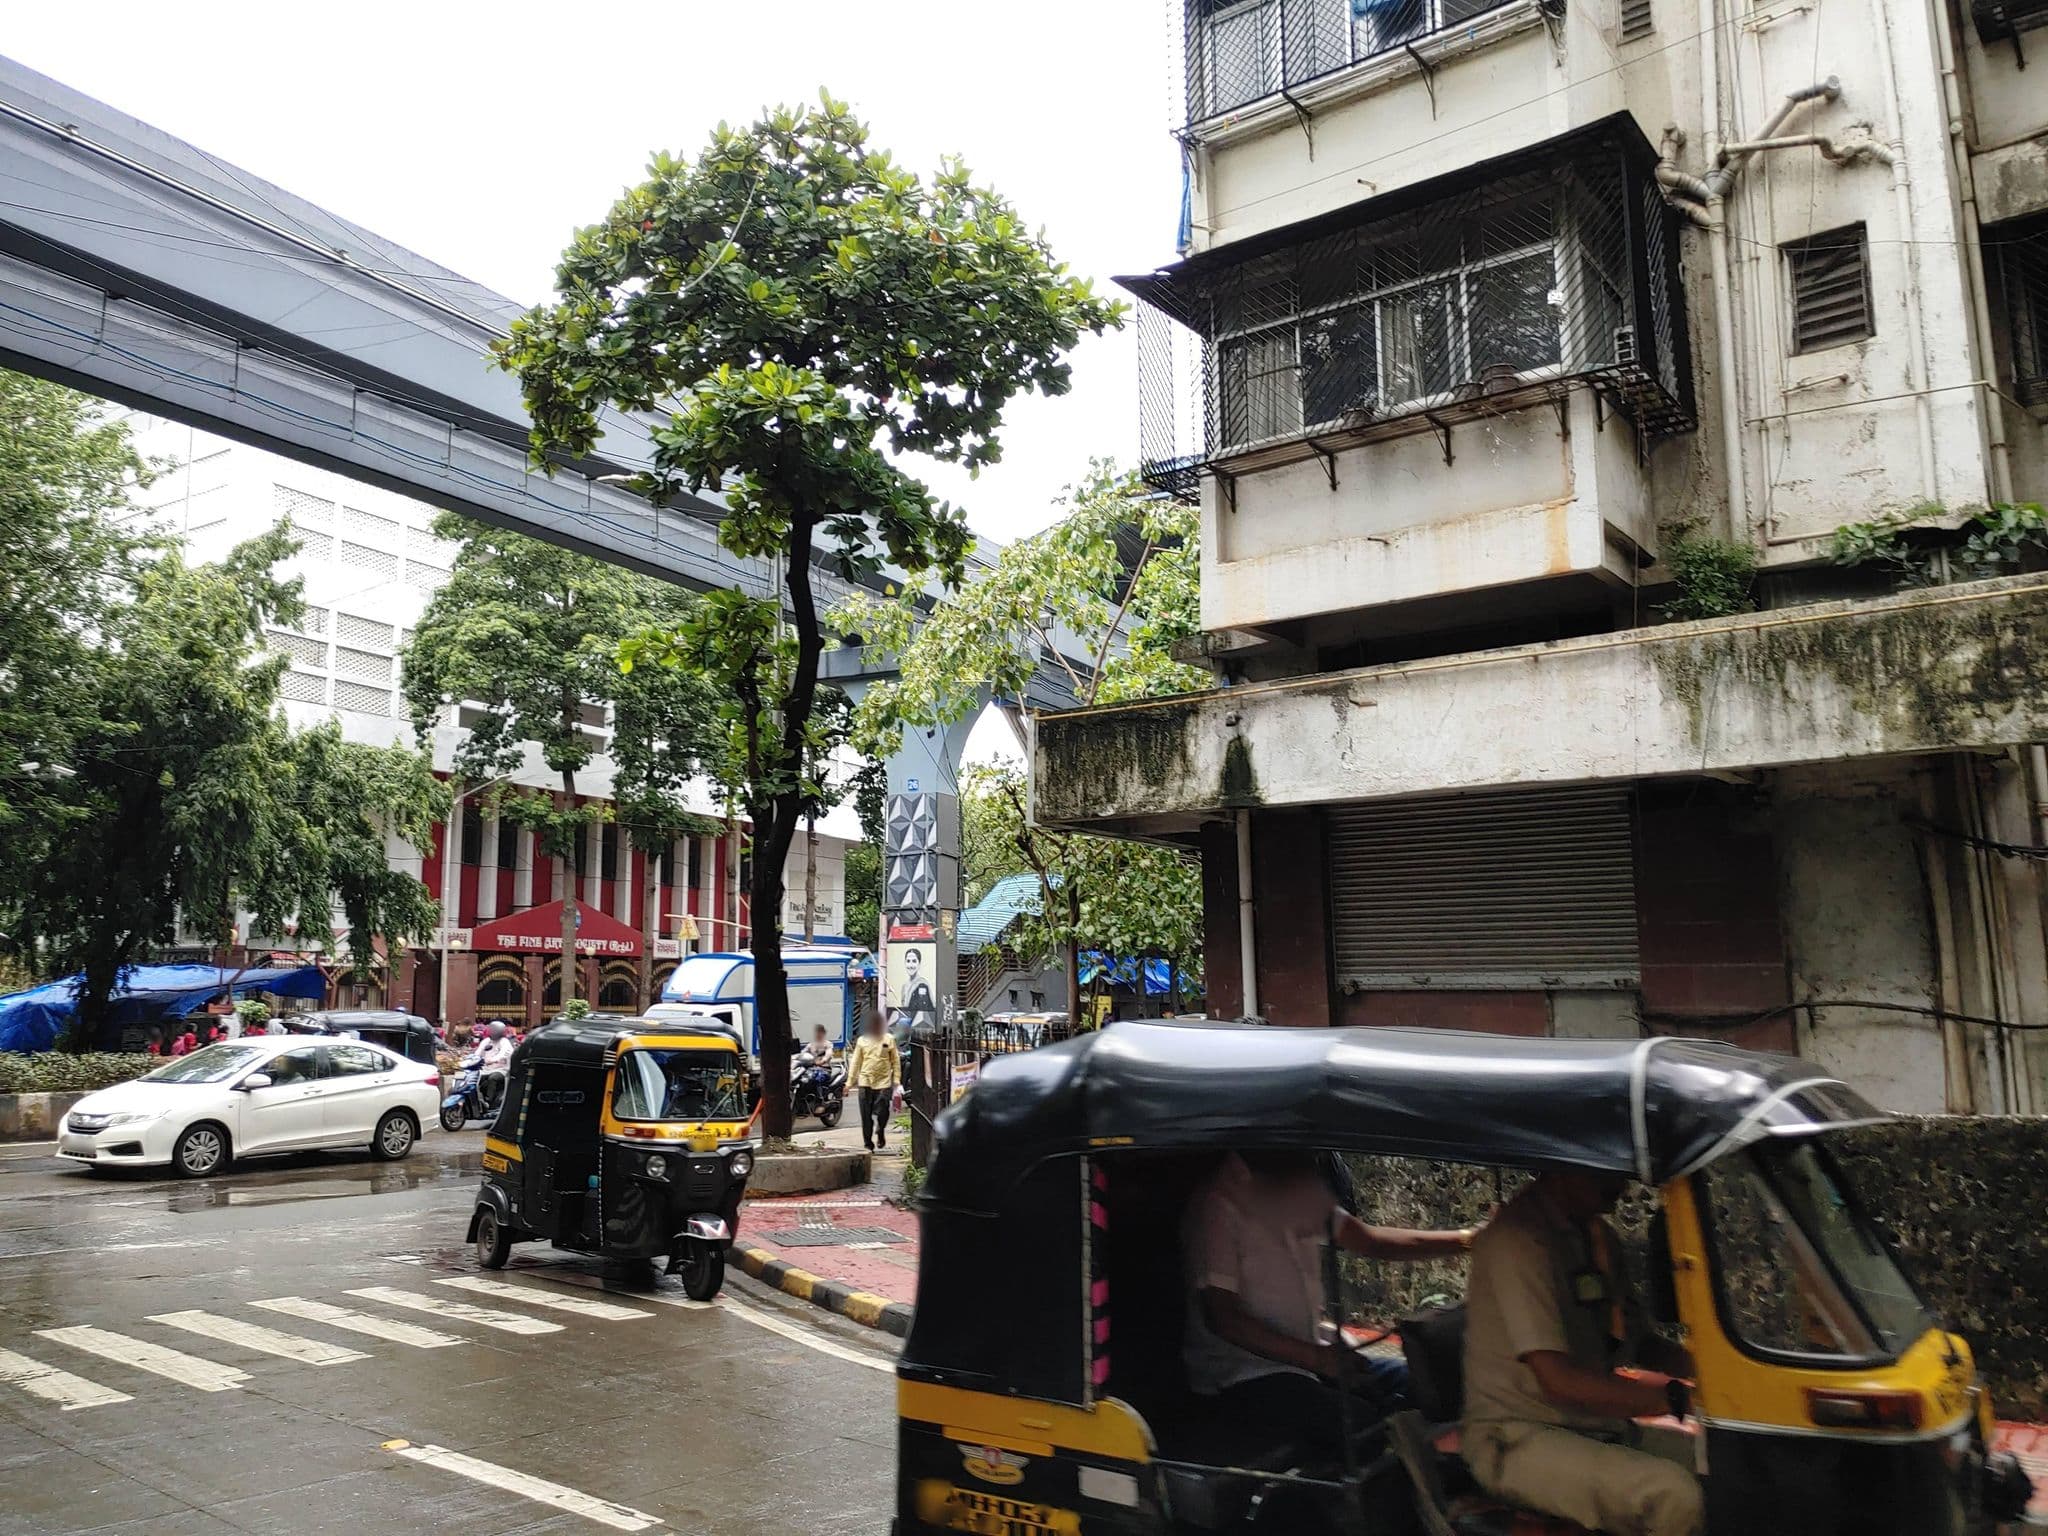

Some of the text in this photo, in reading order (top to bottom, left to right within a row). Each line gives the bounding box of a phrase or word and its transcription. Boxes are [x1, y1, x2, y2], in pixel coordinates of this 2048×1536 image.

[497, 935, 516, 948] THE
[519, 936, 542, 947] FINE
[575, 939, 608, 950] OCIETY
